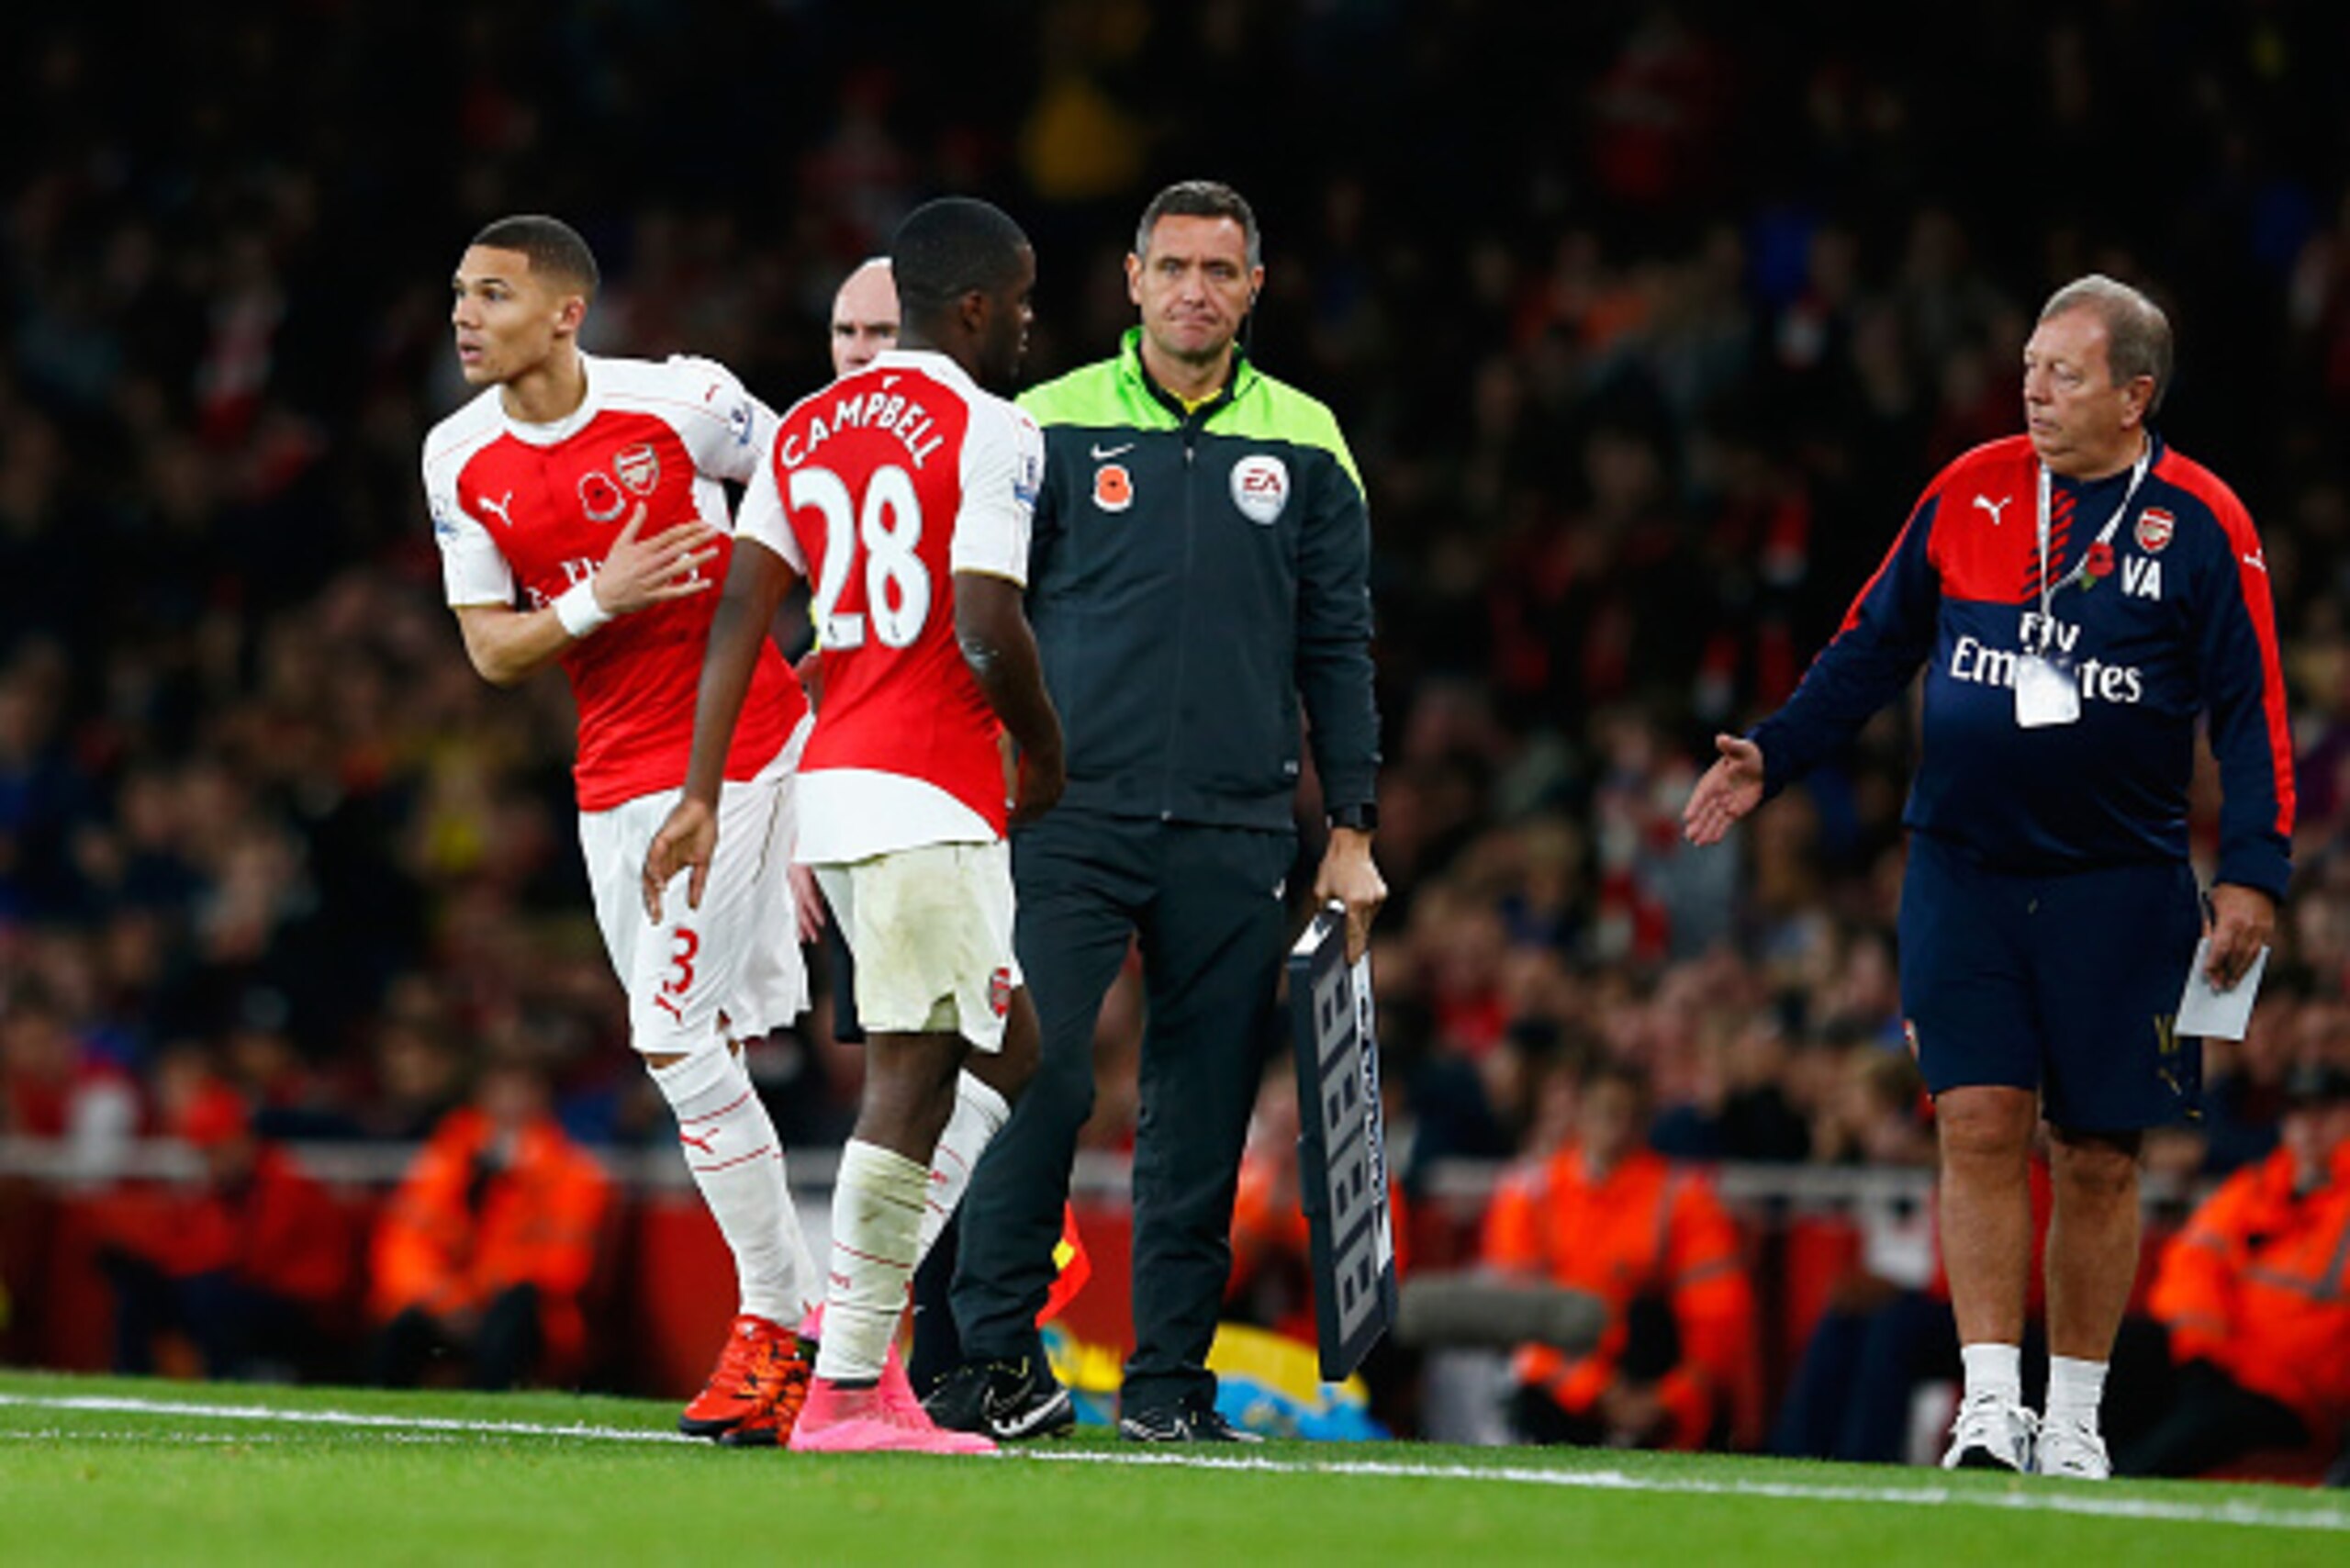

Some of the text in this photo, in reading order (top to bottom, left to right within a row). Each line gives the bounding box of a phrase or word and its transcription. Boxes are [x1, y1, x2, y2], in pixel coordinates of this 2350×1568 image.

[781, 392, 944, 470] CAMPBELL
[1243, 468, 1281, 493] EA
[789, 465, 932, 650] 28
[2121, 554, 2161, 601] VA
[1951, 634, 2143, 703] Emtes
[663, 927, 699, 995] 3
